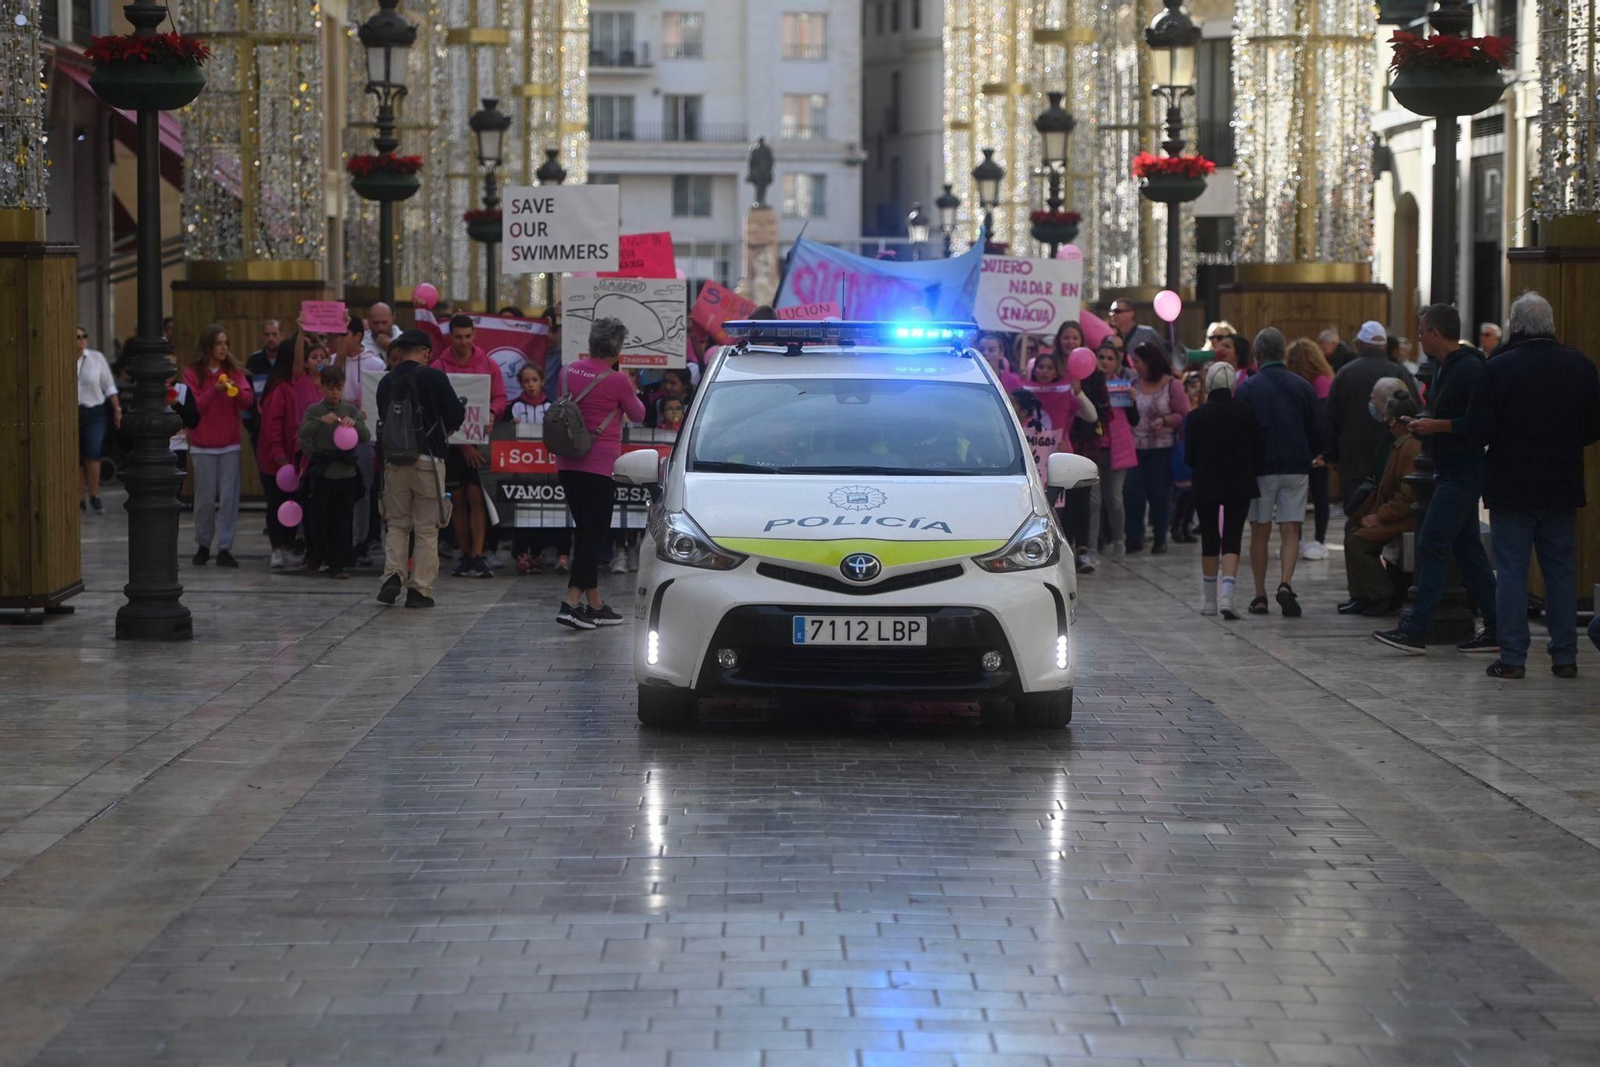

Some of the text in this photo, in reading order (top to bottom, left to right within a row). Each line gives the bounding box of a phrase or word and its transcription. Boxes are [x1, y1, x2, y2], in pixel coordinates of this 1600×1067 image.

[511, 197, 555, 215] SAVE
[509, 221, 549, 238] OUR
[511, 243, 609, 261] SWIMMERS
[980, 258, 1033, 276] QUIERO
[1008, 279, 1080, 297] NADAR EN
[501, 484, 651, 502] VAMOS ESA
[763, 515, 953, 534] POLICÍA
[810, 620, 869, 641] 7112
[877, 620, 921, 641] LBP
